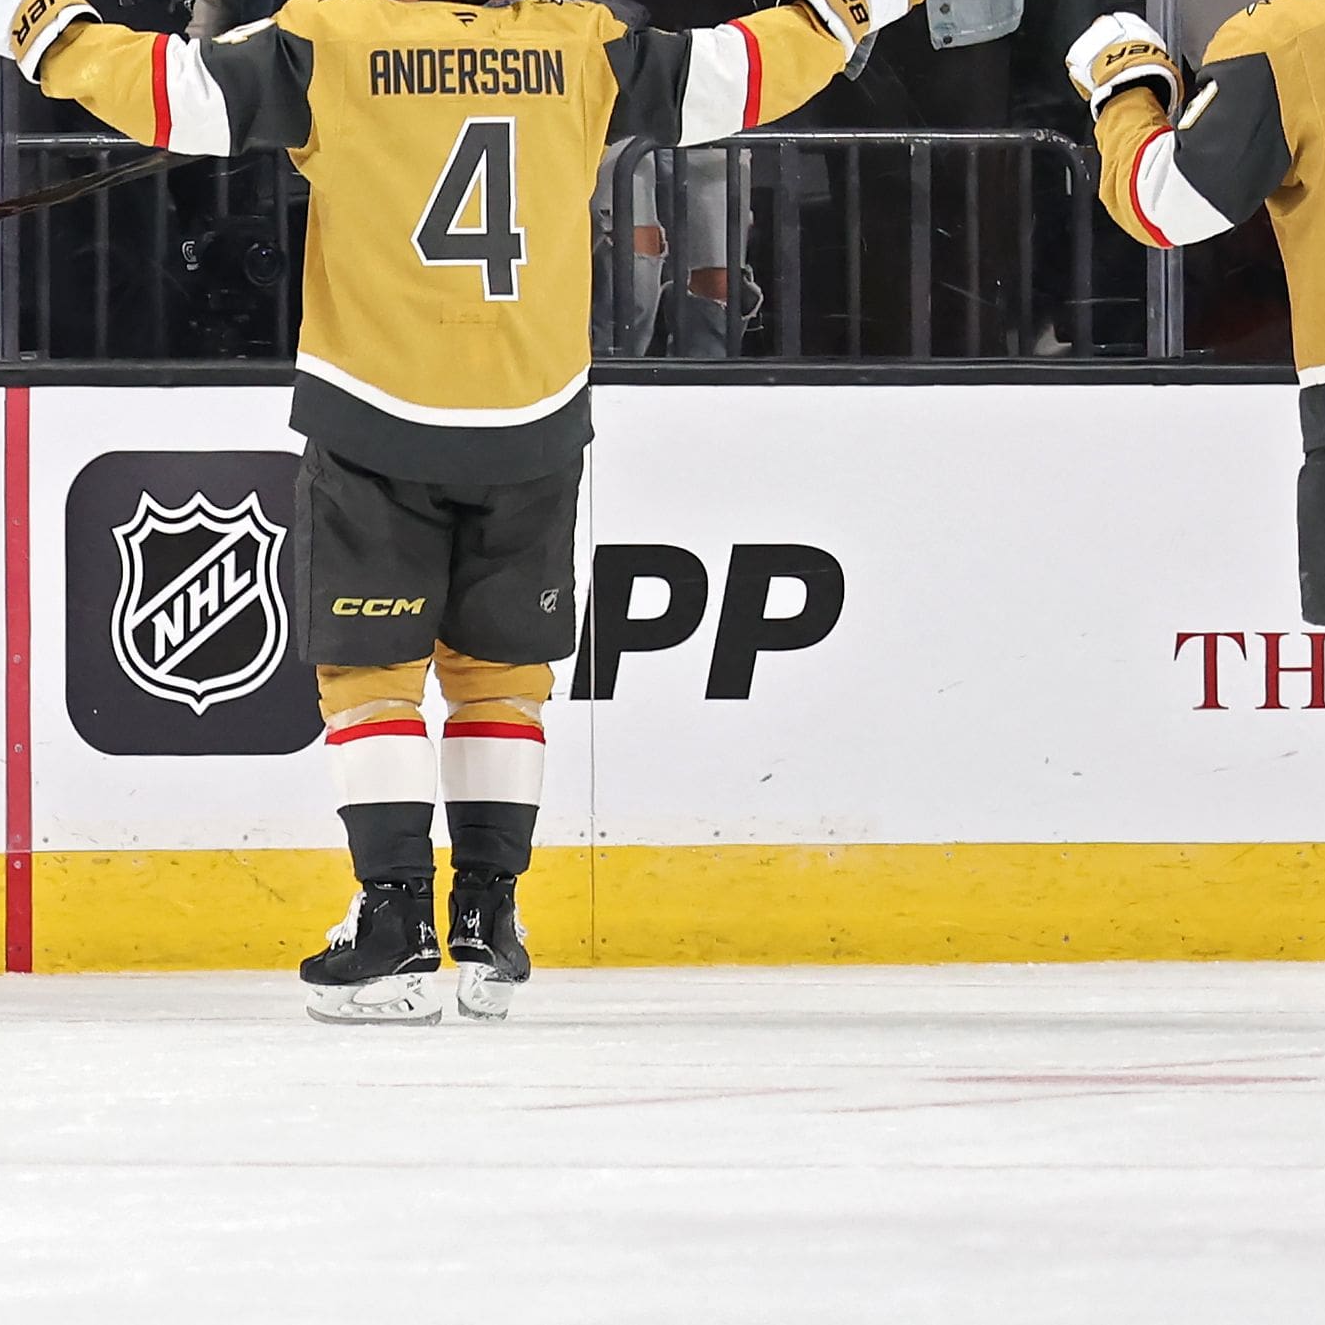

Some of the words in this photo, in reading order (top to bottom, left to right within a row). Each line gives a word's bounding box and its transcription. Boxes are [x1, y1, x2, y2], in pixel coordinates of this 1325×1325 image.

[370, 48, 564, 95] ANDERSSON
[410, 115, 527, 303] 4
[151, 549, 252, 664] NHL
[331, 596, 426, 618] CCM
[547, 543, 845, 701] PP
